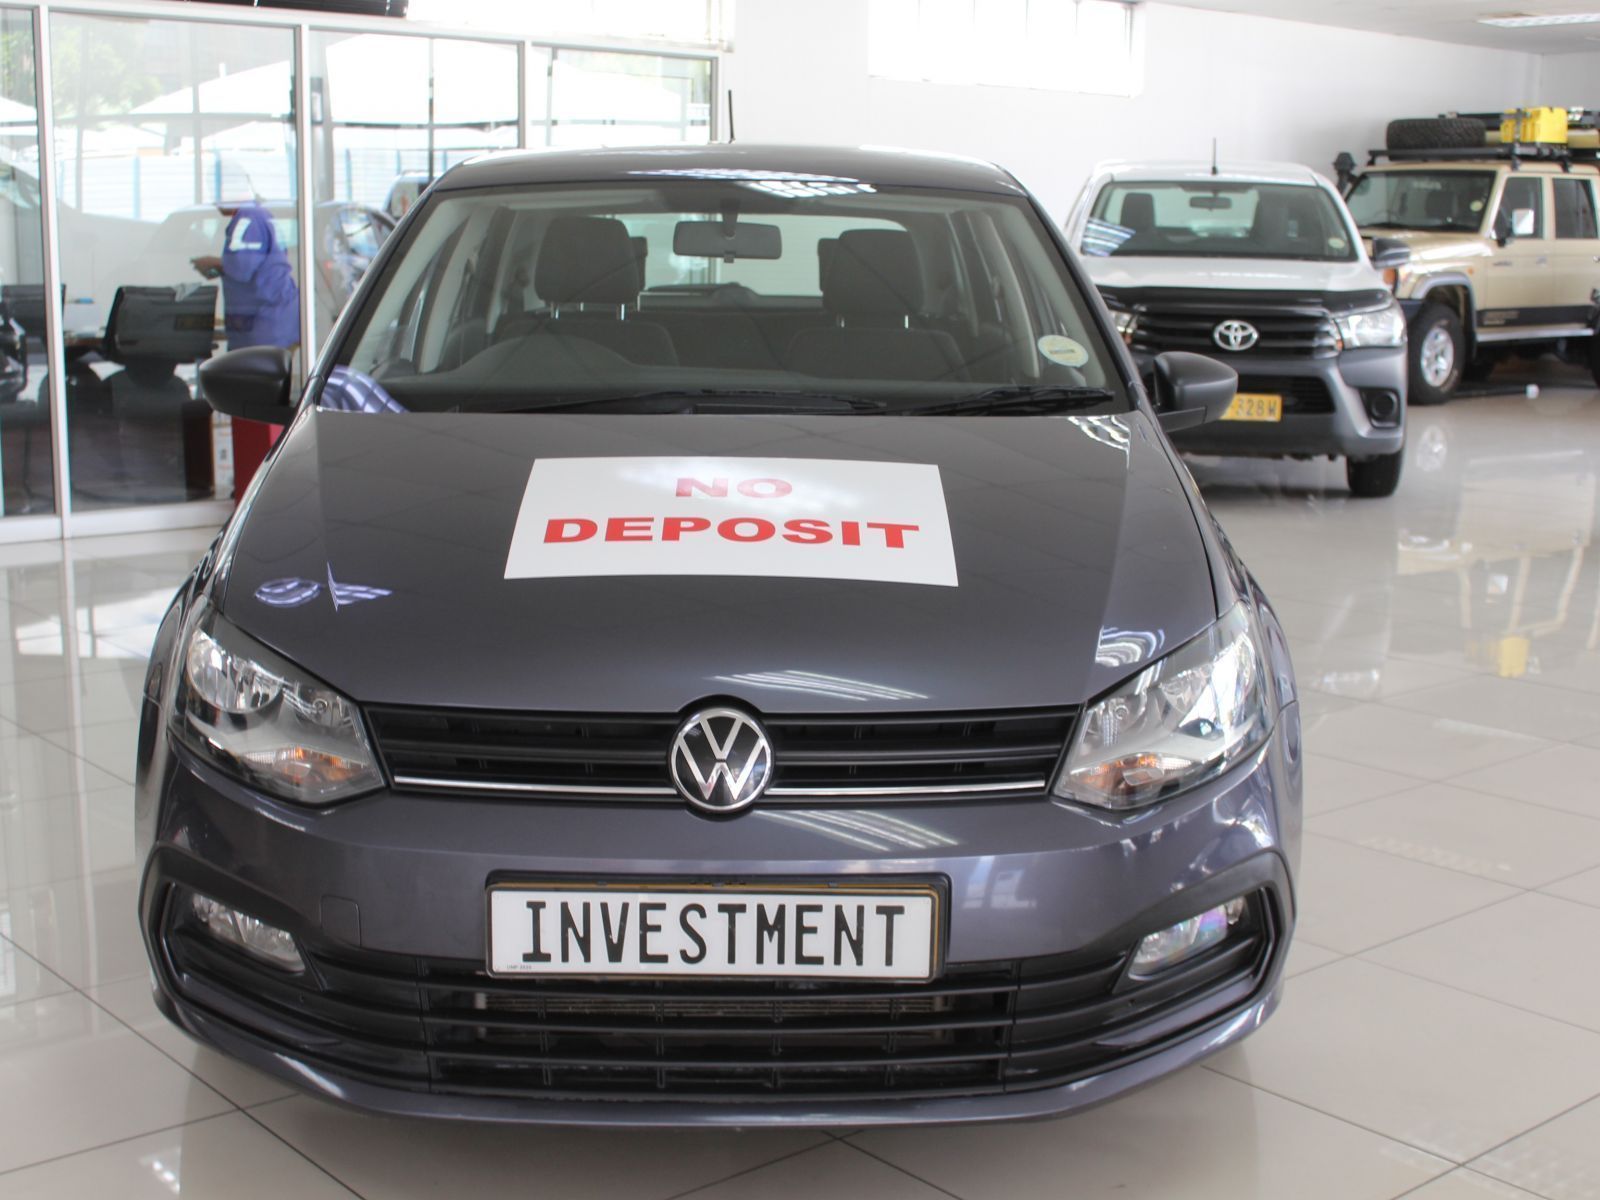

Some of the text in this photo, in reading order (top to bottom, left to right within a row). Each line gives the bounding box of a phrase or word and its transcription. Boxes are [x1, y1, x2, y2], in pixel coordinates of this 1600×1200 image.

[675, 477, 793, 498] NO
[543, 515, 920, 549] DEPOSIT
[522, 901, 905, 966] INVESTMENT
